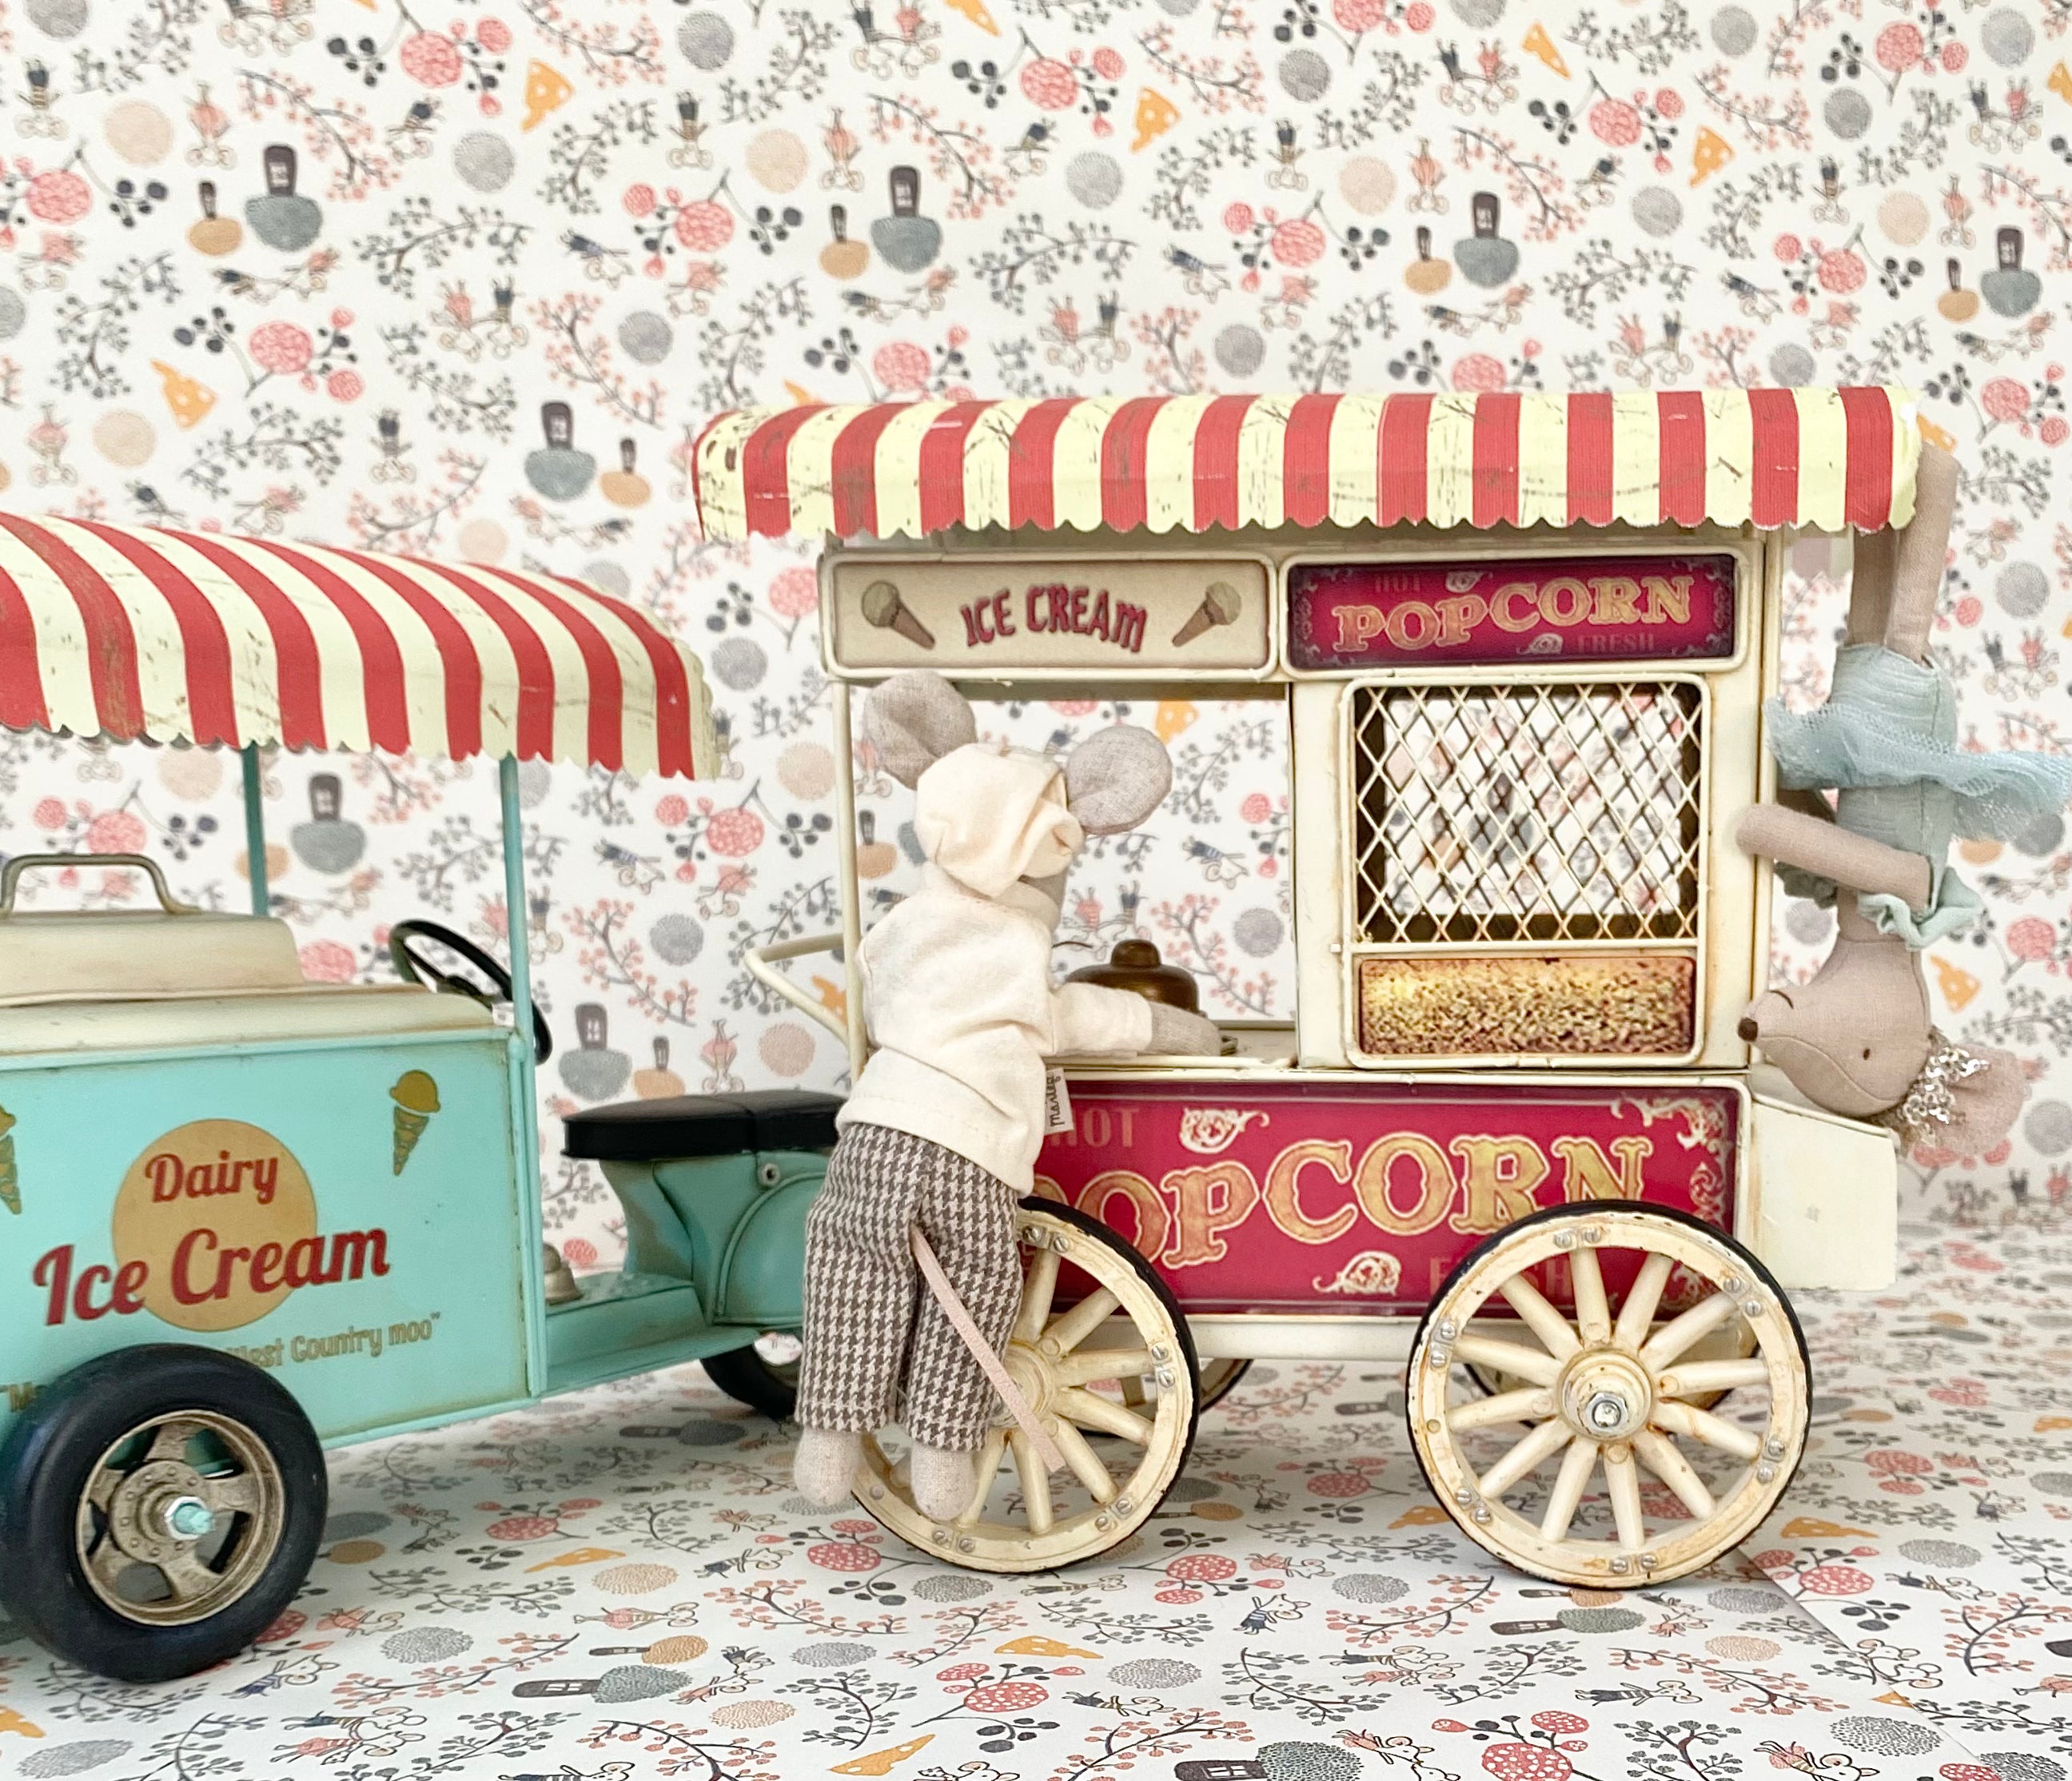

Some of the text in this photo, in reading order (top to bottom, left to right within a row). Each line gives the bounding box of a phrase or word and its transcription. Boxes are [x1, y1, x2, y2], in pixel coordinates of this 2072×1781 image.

[961, 588, 1016, 647] ICE
[1331, 576, 1694, 652] POPCORN
[1577, 633, 1654, 653] FRESH
[145, 1151, 278, 1204] Dairy
[1031, 1131, 1653, 1269] OPCORN
[33, 1228, 390, 1326] Ice Cream
[290, 1325, 382, 1362] Country
